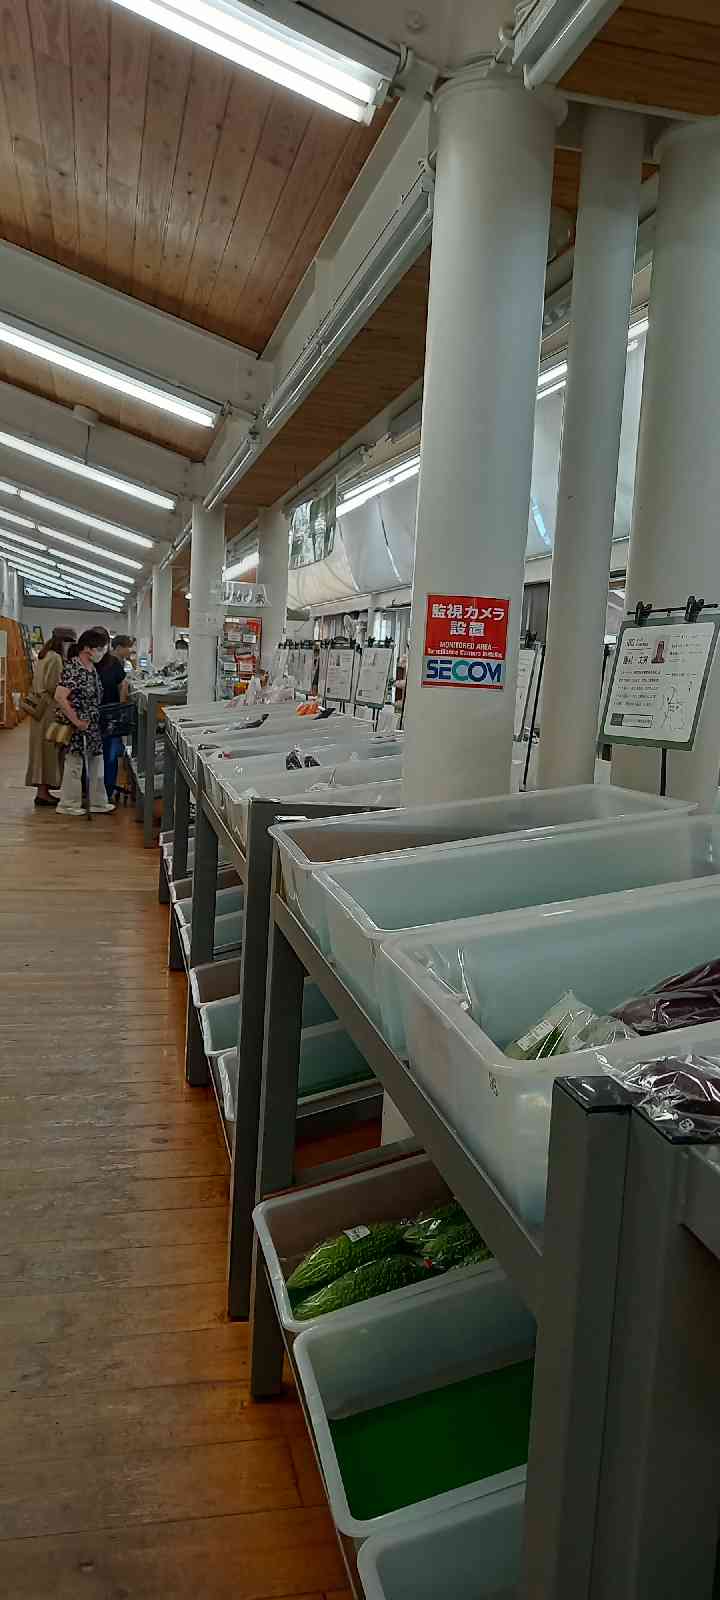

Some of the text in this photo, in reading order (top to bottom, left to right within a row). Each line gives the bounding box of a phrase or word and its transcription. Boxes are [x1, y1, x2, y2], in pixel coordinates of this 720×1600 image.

[431, 603, 504, 621] 監視カメラ
[450, 620, 485, 636] 設置
[440, 641, 474, 650] MONITORED
[426, 660, 502, 682] SECOM
